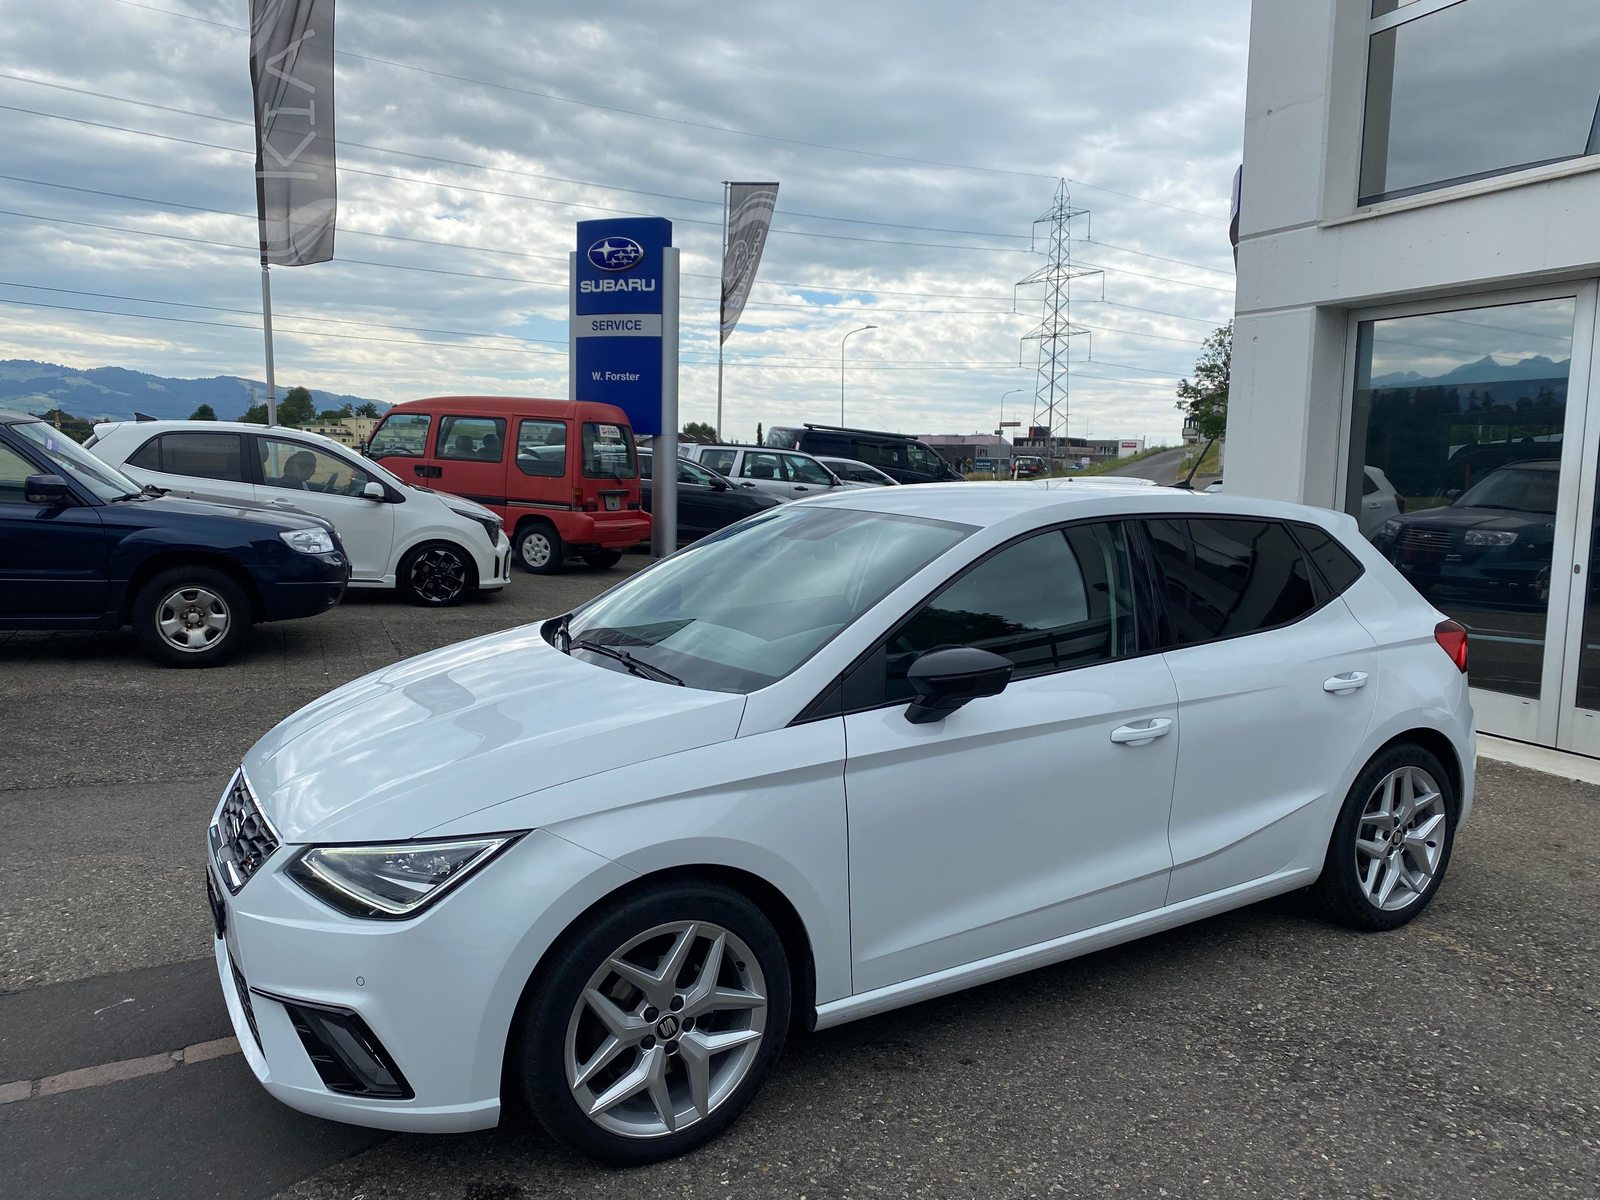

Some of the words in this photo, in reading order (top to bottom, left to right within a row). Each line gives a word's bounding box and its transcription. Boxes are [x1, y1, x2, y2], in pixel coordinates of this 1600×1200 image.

[580, 278, 656, 293] SUBARU
[591, 319, 642, 331] SERVICE
[591, 371, 604, 381] W.
[605, 371, 640, 381] Forster
